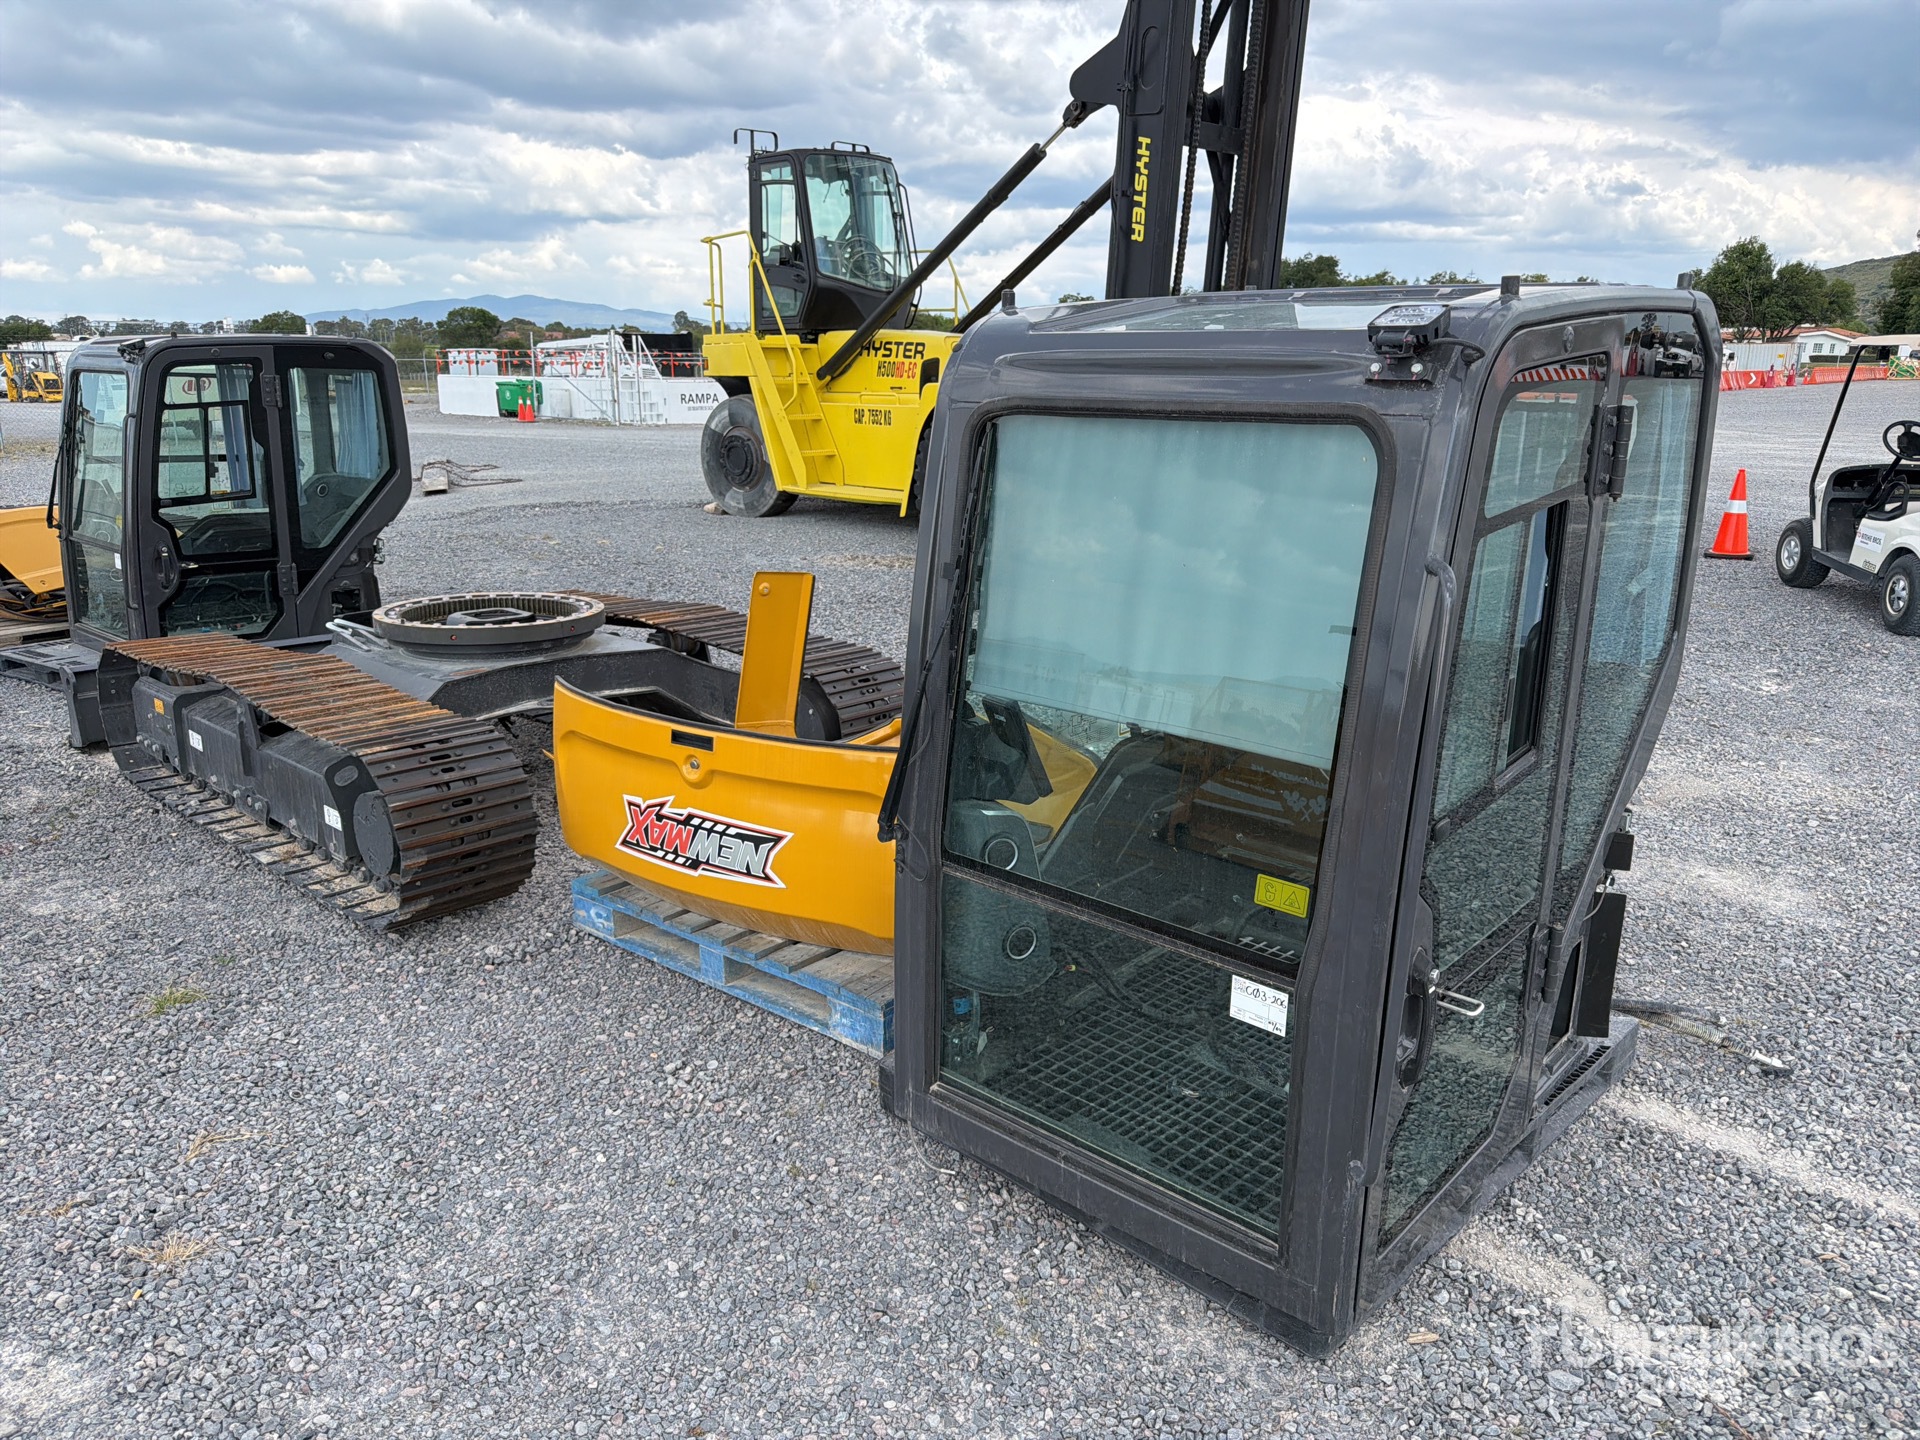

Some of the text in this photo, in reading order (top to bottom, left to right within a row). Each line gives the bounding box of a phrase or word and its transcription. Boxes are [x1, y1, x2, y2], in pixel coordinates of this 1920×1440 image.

[1131, 136, 1151, 242] HYSTER
[877, 361, 917, 379] H500HD-EC
[680, 393, 719, 404] RAMPA
[868, 409, 882, 425] 7552
[884, 410, 892, 426] KG
